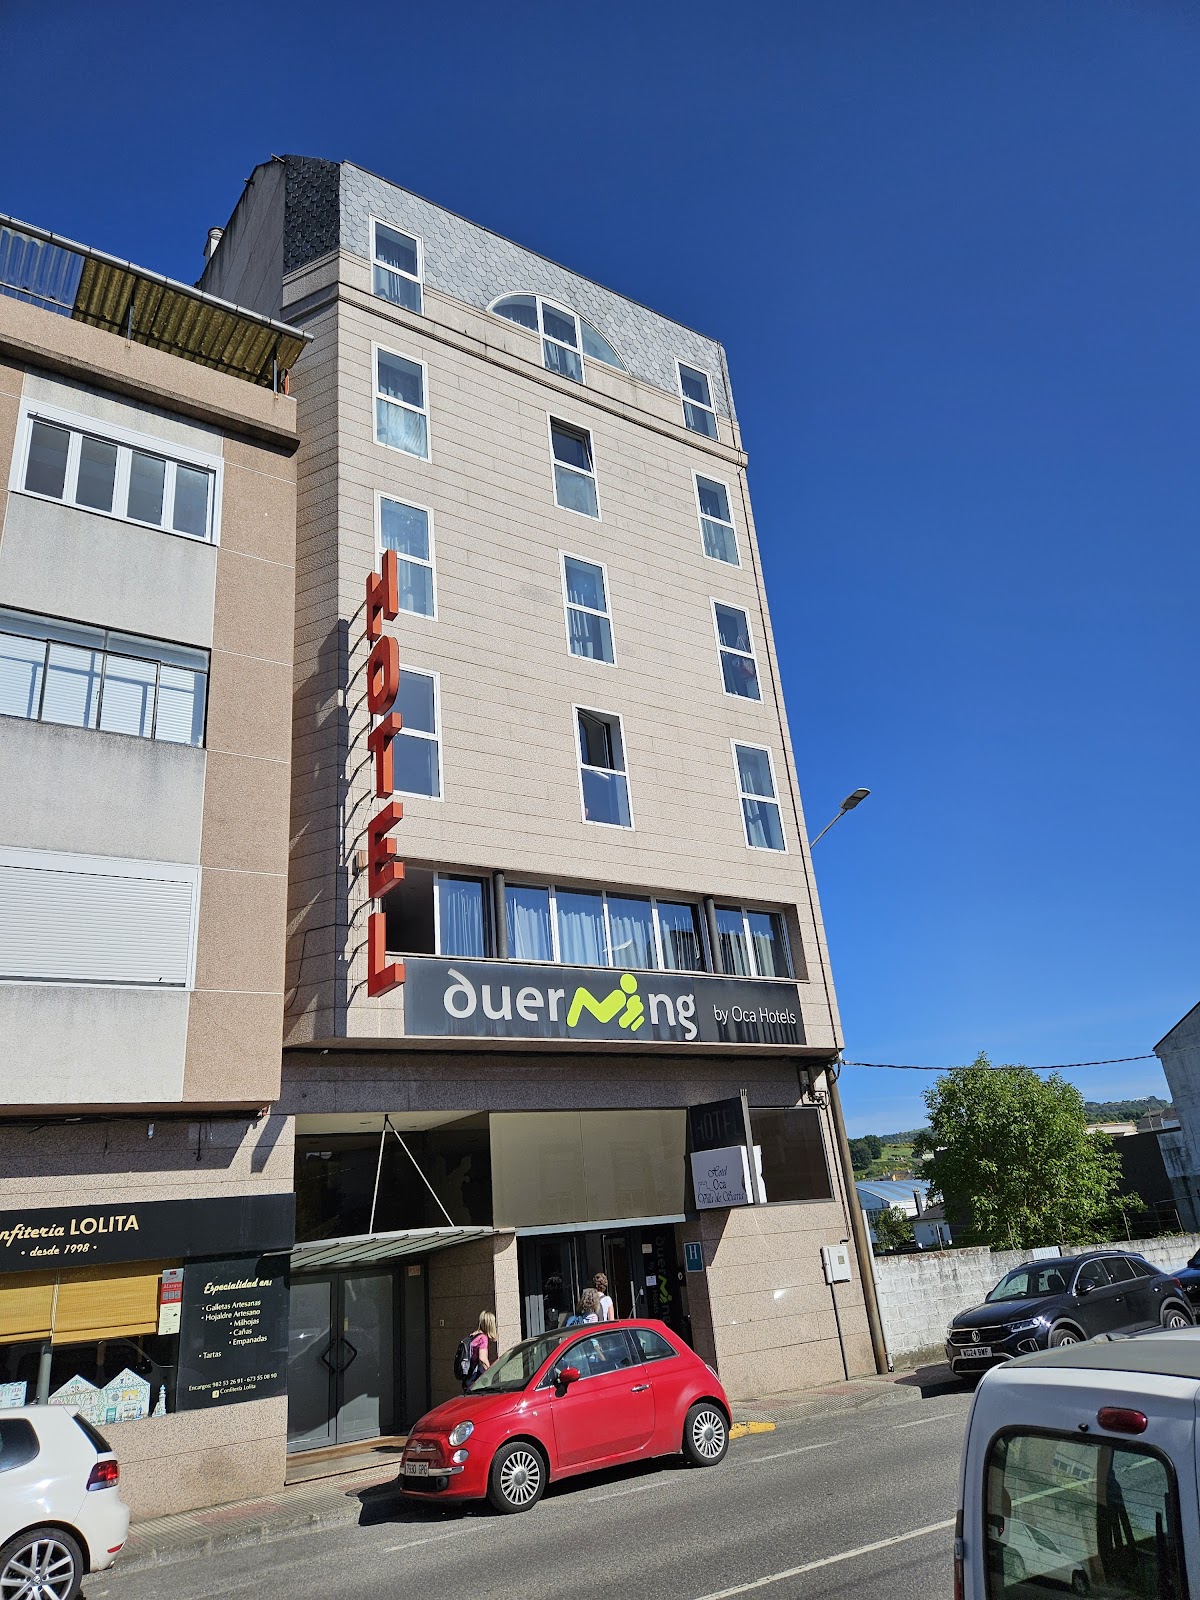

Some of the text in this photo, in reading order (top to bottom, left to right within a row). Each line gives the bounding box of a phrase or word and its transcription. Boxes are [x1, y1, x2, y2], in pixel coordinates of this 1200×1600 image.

[366, 550, 405, 998] HOTEL
[713, 1005, 797, 1025] by Oca Hotels
[708, 1165, 728, 1178] Hotel
[712, 1179, 727, 1190] Oca
[70, 1214, 139, 1235] LOLITA
[29, 1243, 91, 1257] desde 1998
[689, 1245, 698, 1259] H
[203, 1278, 273, 1295] Especialidad en:
[205, 1300, 261, 1312] Galletas Artesanas
[205, 1309, 260, 1322] Hojaldre Artesano
[233, 1318, 260, 1327] Milhojas
[232, 1335, 268, 1346] Empanadas
[203, 1351, 222, 1359] Tartas
